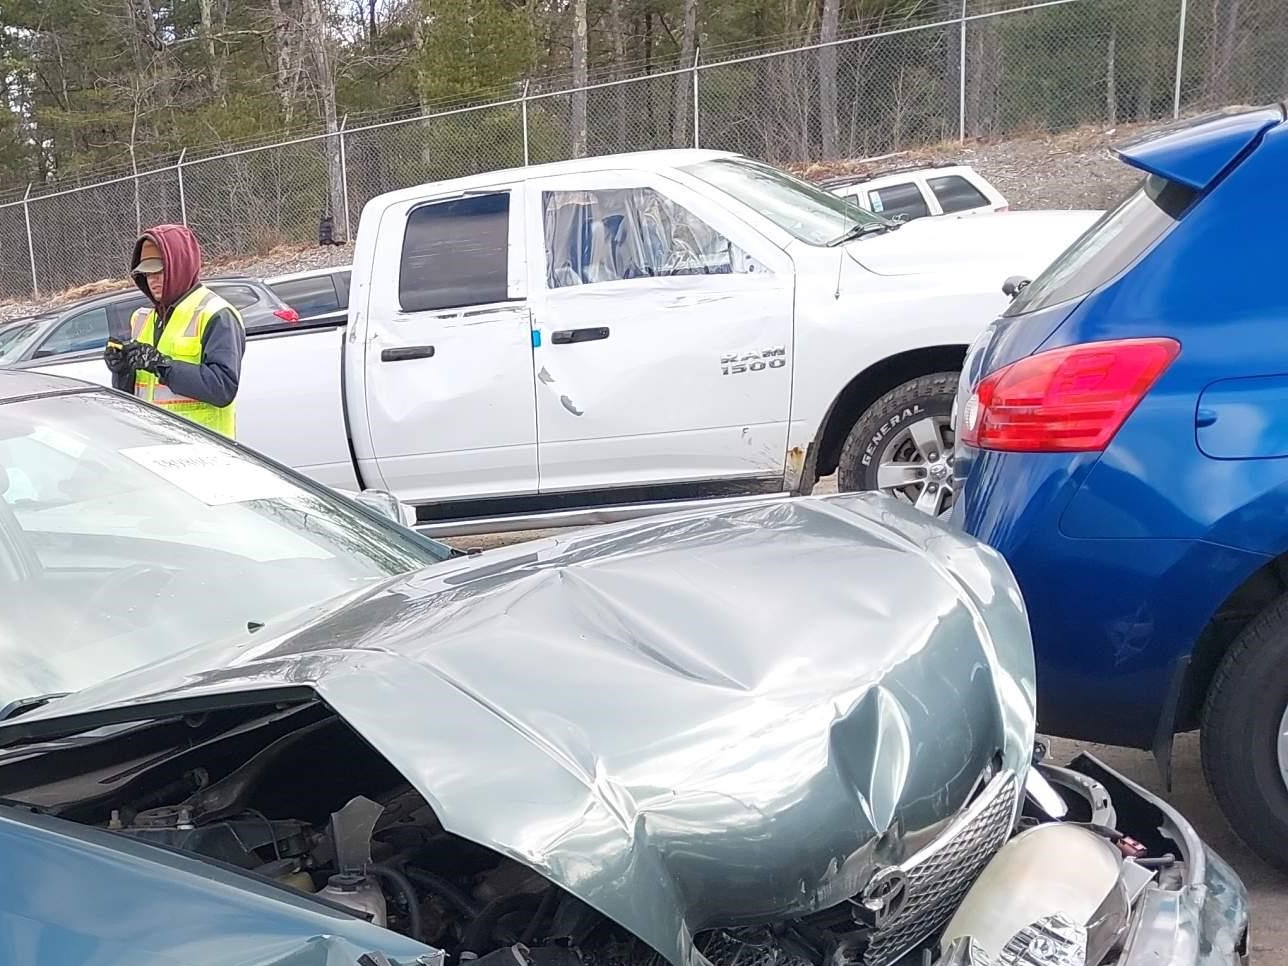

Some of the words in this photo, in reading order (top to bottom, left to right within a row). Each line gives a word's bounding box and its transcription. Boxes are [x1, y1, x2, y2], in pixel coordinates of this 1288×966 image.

[720, 346, 786, 364] RAM
[720, 358, 786, 376] 1500
[861, 404, 925, 467] GENERAL
